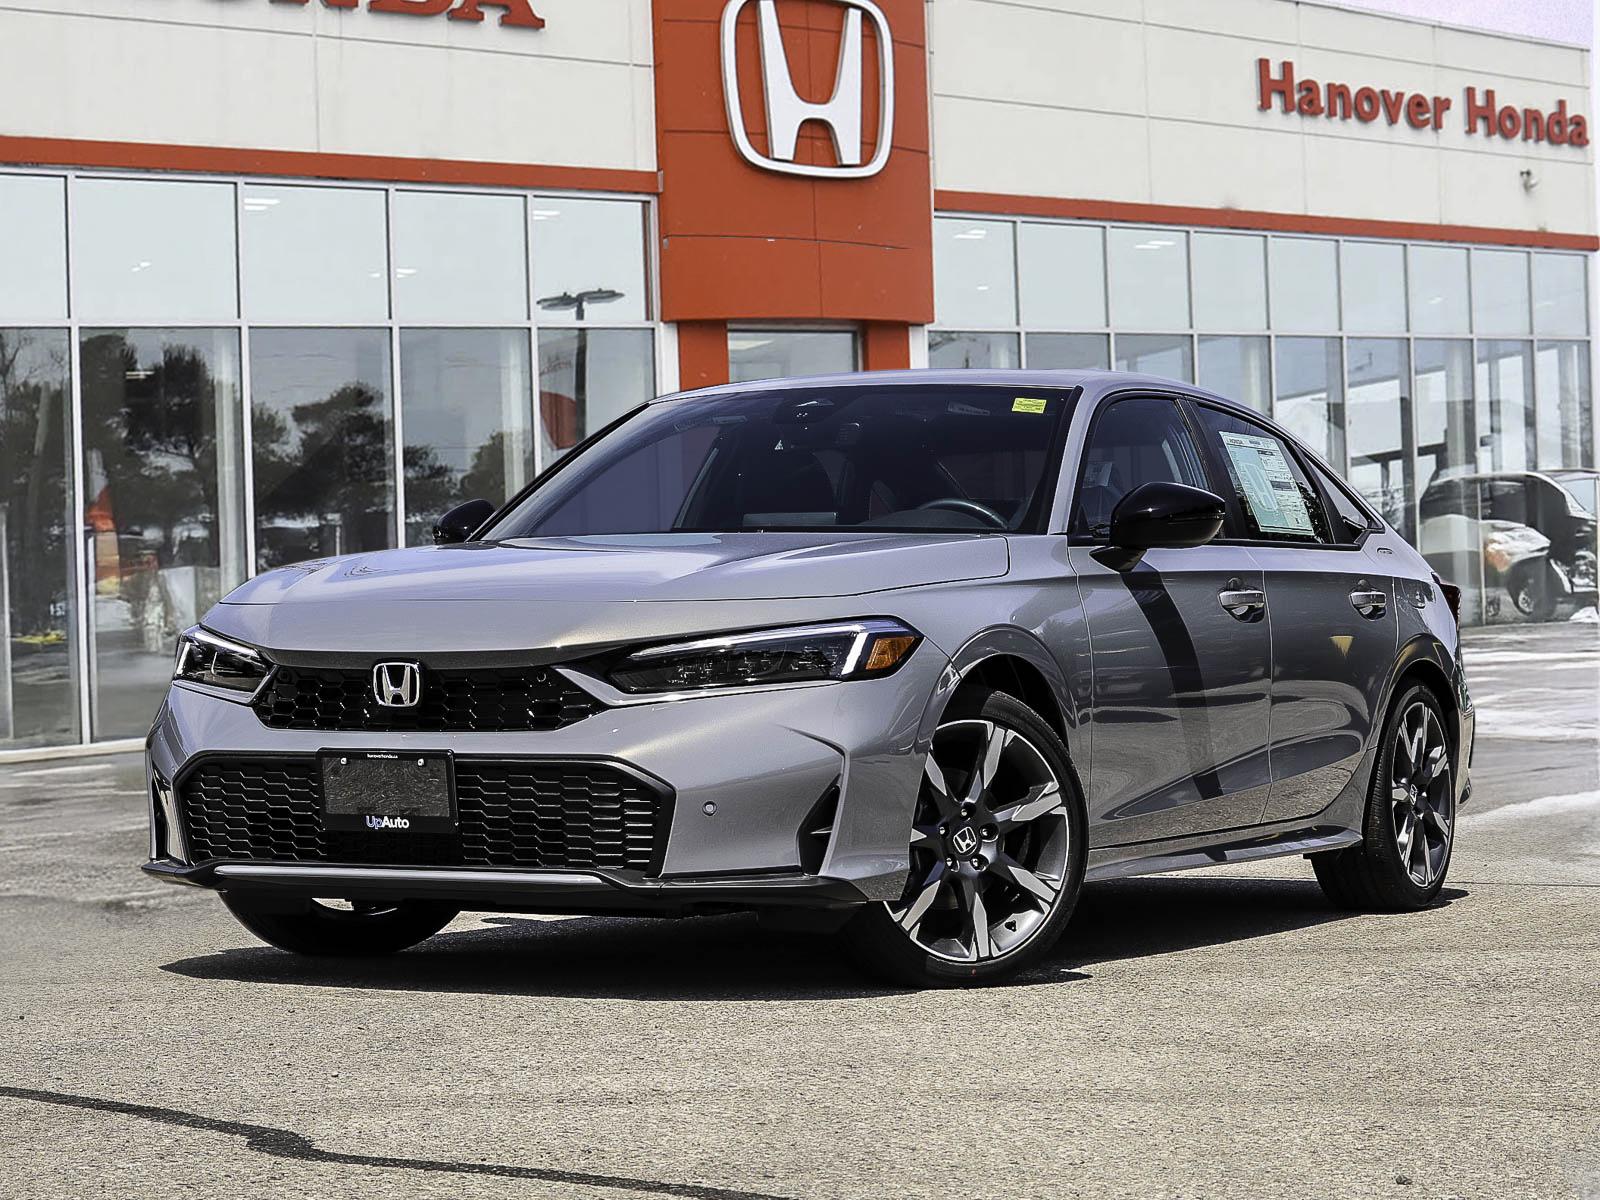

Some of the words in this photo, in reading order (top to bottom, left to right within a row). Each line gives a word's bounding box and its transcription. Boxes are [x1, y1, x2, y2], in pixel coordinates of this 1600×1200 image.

[1256, 57, 1452, 131] Hanover
[1465, 86, 1590, 148] Honda
[365, 815, 410, 830] UpAuto
